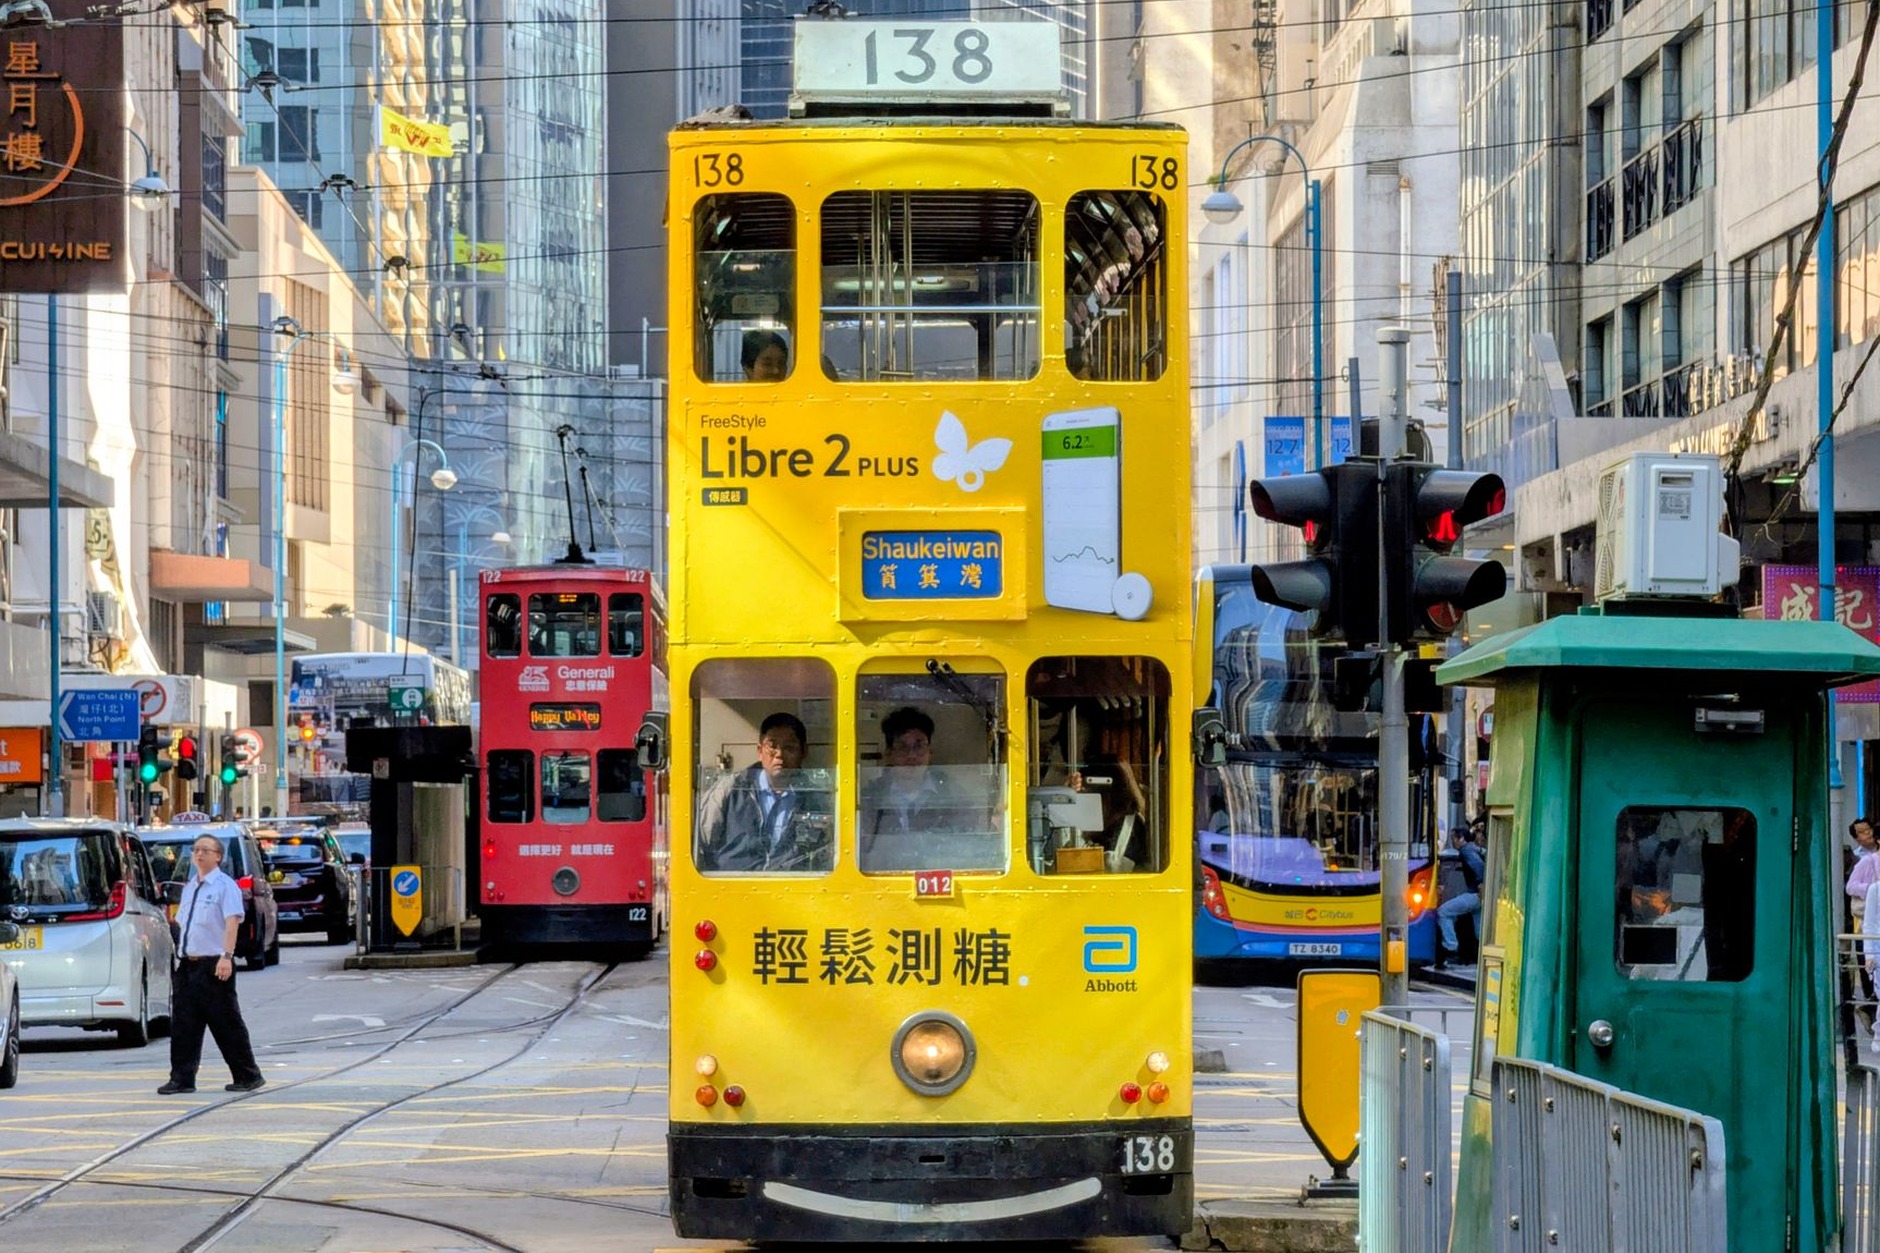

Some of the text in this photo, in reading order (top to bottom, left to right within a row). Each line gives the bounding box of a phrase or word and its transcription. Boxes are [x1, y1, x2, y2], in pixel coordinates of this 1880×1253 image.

[865, 28, 993, 85] 138
[1, 41, 60, 172] 星月樓
[694, 153, 744, 187] 138
[1132, 154, 1178, 190] 138
[0, 242, 111, 260] CUISINE
[701, 414, 767, 430] FreeStyle
[1062, 435, 1083, 450] 6.2
[701, 433, 919, 478] Libre 2 PLUS
[708, 490, 742, 503] 傳感器
[863, 537, 999, 559] Shaukeiwan
[482, 571, 501, 584] 122
[625, 570, 645, 583] 122
[880, 562, 982, 589] 筲箕灣
[558, 665, 615, 679] Generali
[77, 691, 138, 702] Wan Chai (N)
[78, 715, 126, 724] North Point
[530, 710, 560, 725] Happy
[176, 813, 206, 822] TAXI
[918, 876, 951, 894] 012
[628, 907, 647, 921] 122
[752, 926, 1012, 986] 輕鬆測糖
[1293, 944, 1339, 954] TZ 8340
[1085, 979, 1138, 992] Abbott
[1124, 1134, 1175, 1174] 138
